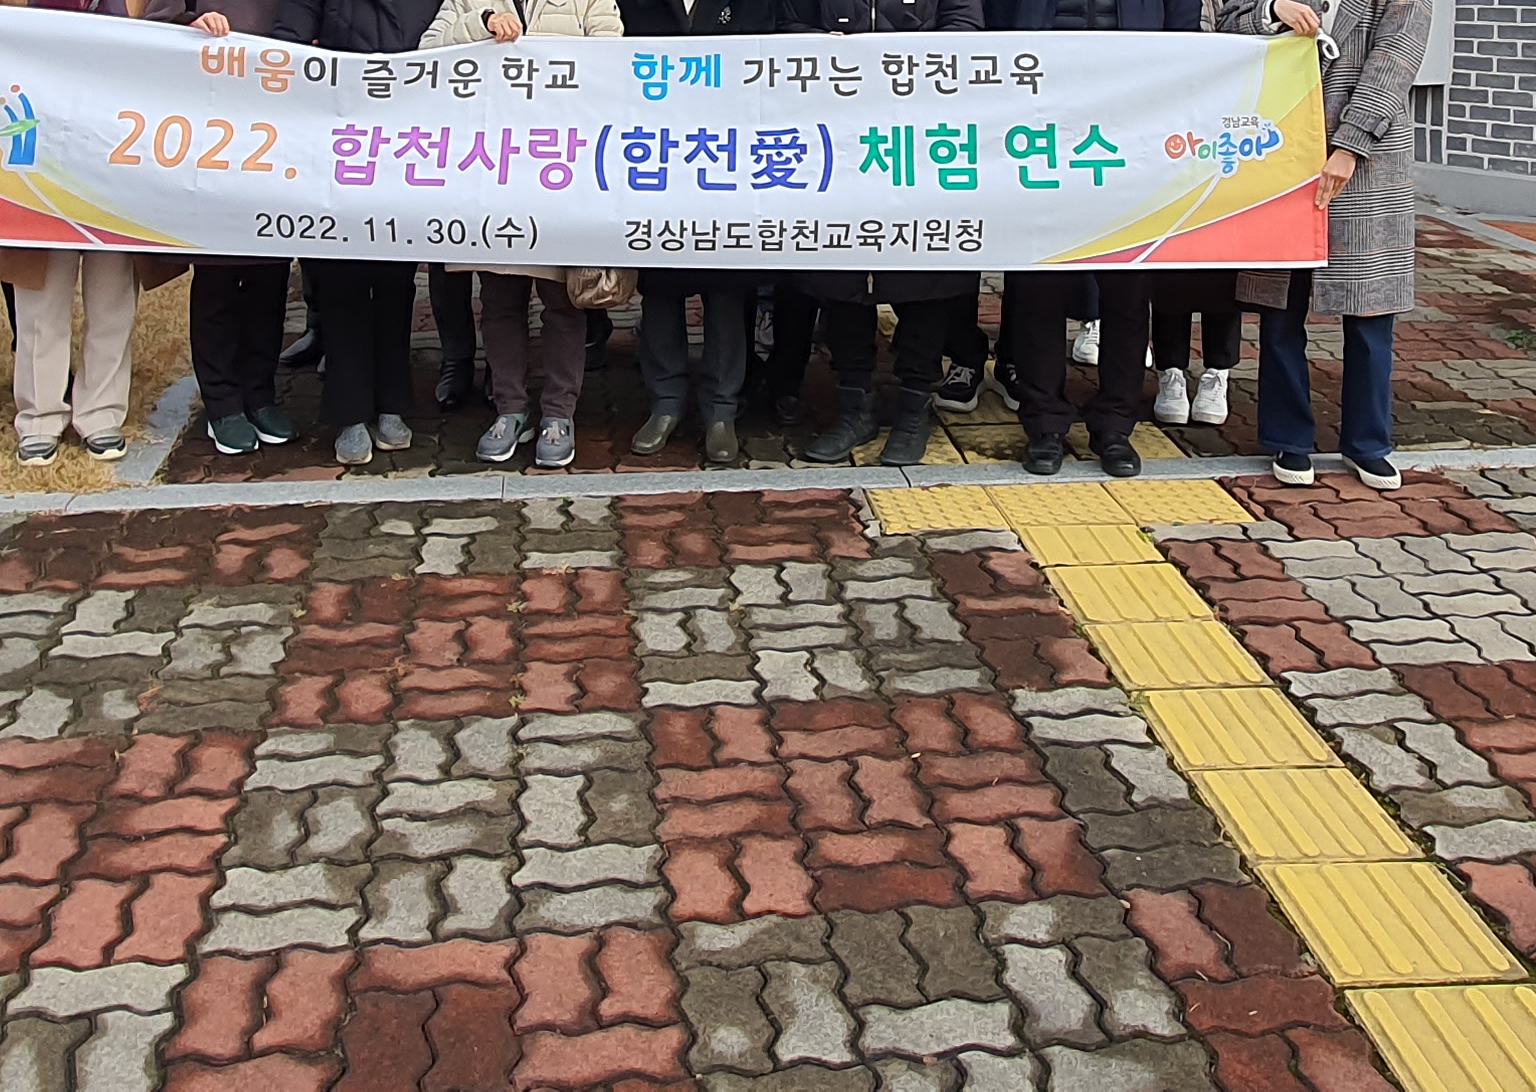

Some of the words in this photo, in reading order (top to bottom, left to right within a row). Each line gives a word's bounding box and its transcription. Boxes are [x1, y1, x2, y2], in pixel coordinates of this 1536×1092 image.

[361, 57, 482, 99] 즐거운
[500, 56, 579, 100] 학교
[631, 51, 722, 100] 함께
[743, 55, 863, 97] 가꾸는
[881, 52, 1045, 96] 합천교육
[1222, 116, 1259, 129] 경남교육
[107, 111, 298, 180] 2022.
[859, 125, 978, 191] 체험
[1003, 125, 1126, 188] 연수
[1164, 128, 1280, 174] 아이좋아
[255, 212, 350, 242] 2022.
[623, 219, 985, 252] 경상남도합천교육지원청
